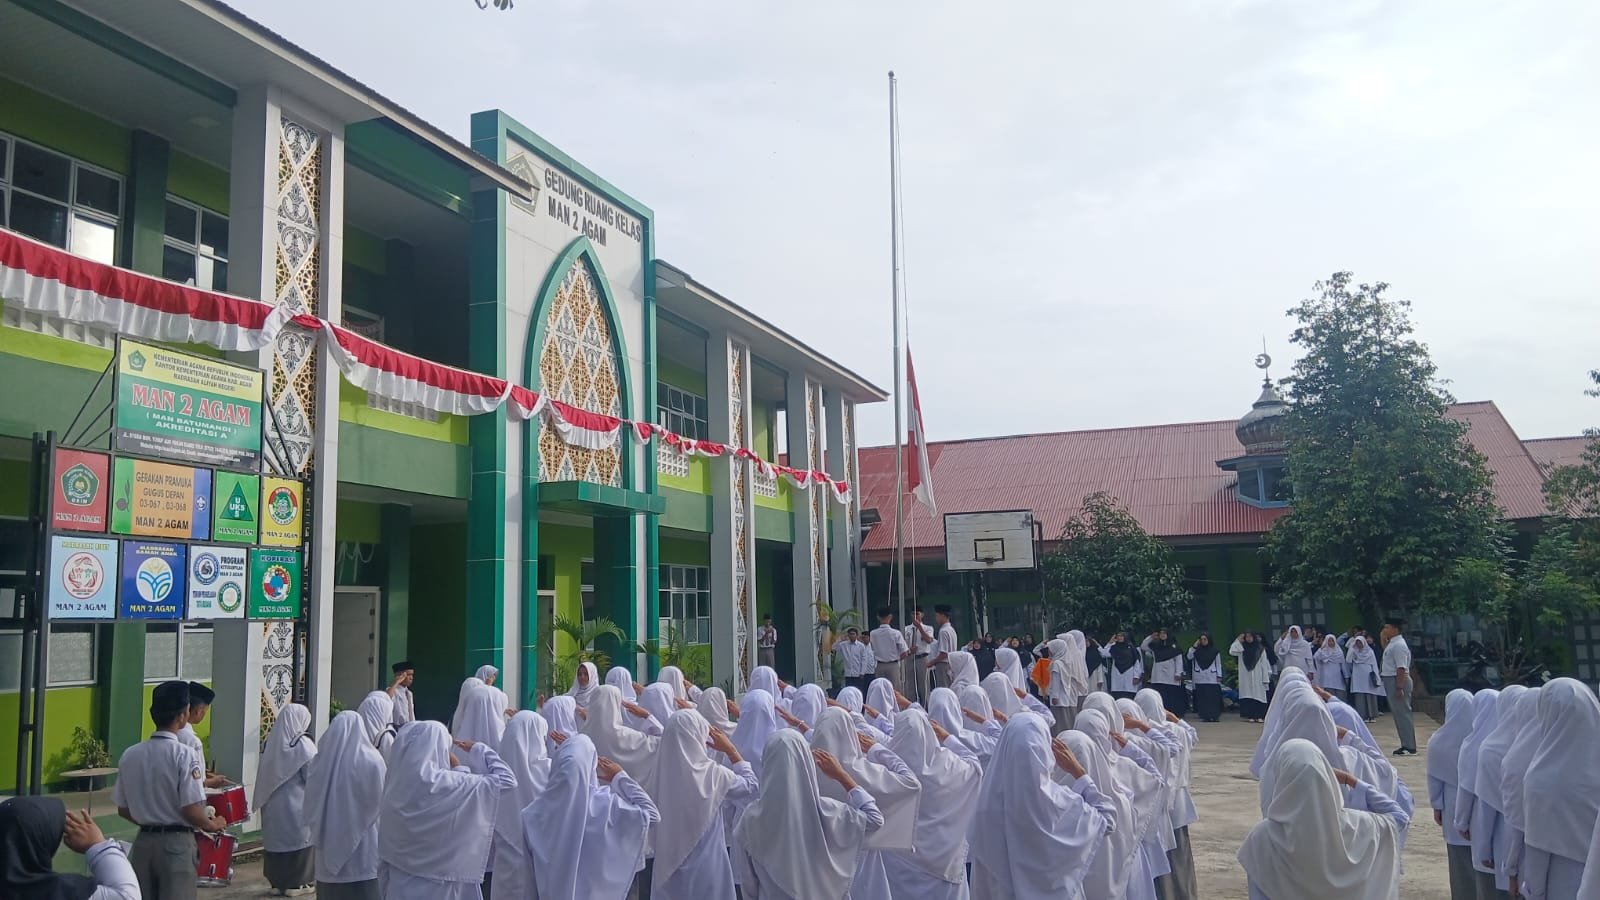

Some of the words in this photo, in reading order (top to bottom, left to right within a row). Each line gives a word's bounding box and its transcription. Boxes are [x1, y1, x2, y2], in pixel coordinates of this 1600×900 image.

[545, 168, 583, 207] GEDUNG
[585, 191, 614, 226] RUANG
[615, 212, 641, 243] KELAS
[548, 196, 570, 227] MAN
[572, 211, 579, 231] 2
[581, 217, 607, 247] AGAM
[153, 353, 188, 366] KEMENTERIAN
[189, 361, 206, 371] AGAMA
[206, 365, 229, 376] REPUBLIK
[155, 362, 175, 371] KANTOR
[176, 366, 210, 378] KEMENTERIAN
[211, 373, 227, 383] AGAMA
[173, 373, 200, 385] MADRASAH
[200, 379, 218, 389] ALIYAH
[218, 383, 235, 392] NEGERI
[132, 383, 176, 413] MAN
[179, 394, 193, 417] 2
[196, 398, 251, 427] AGAM
[152, 413, 174, 423] MAN
[176, 417, 231, 433] BATUMANDI
[155, 421, 218, 437] AKREDITASI
[136, 471, 163, 484] GERAKAN
[165, 474, 192, 488] PRAMUKA
[143, 487, 164, 498] GUGUS
[165, 490, 185, 499] DEPAN
[140, 499, 161, 508] 03-067
[229, 503, 246, 511] UKS
[135, 516, 155, 528] MAN
[157, 518, 163, 528] 2
[164, 519, 189, 530] AGAM
[220, 556, 245, 565] PROGRAM
[55, 603, 74, 611] MAN
[77, 603, 82, 611] 2
[84, 603, 107, 611] AGAM
[129, 605, 146, 613] MAN
[148, 605, 153, 613] 2
[154, 605, 176, 613] AGAM
